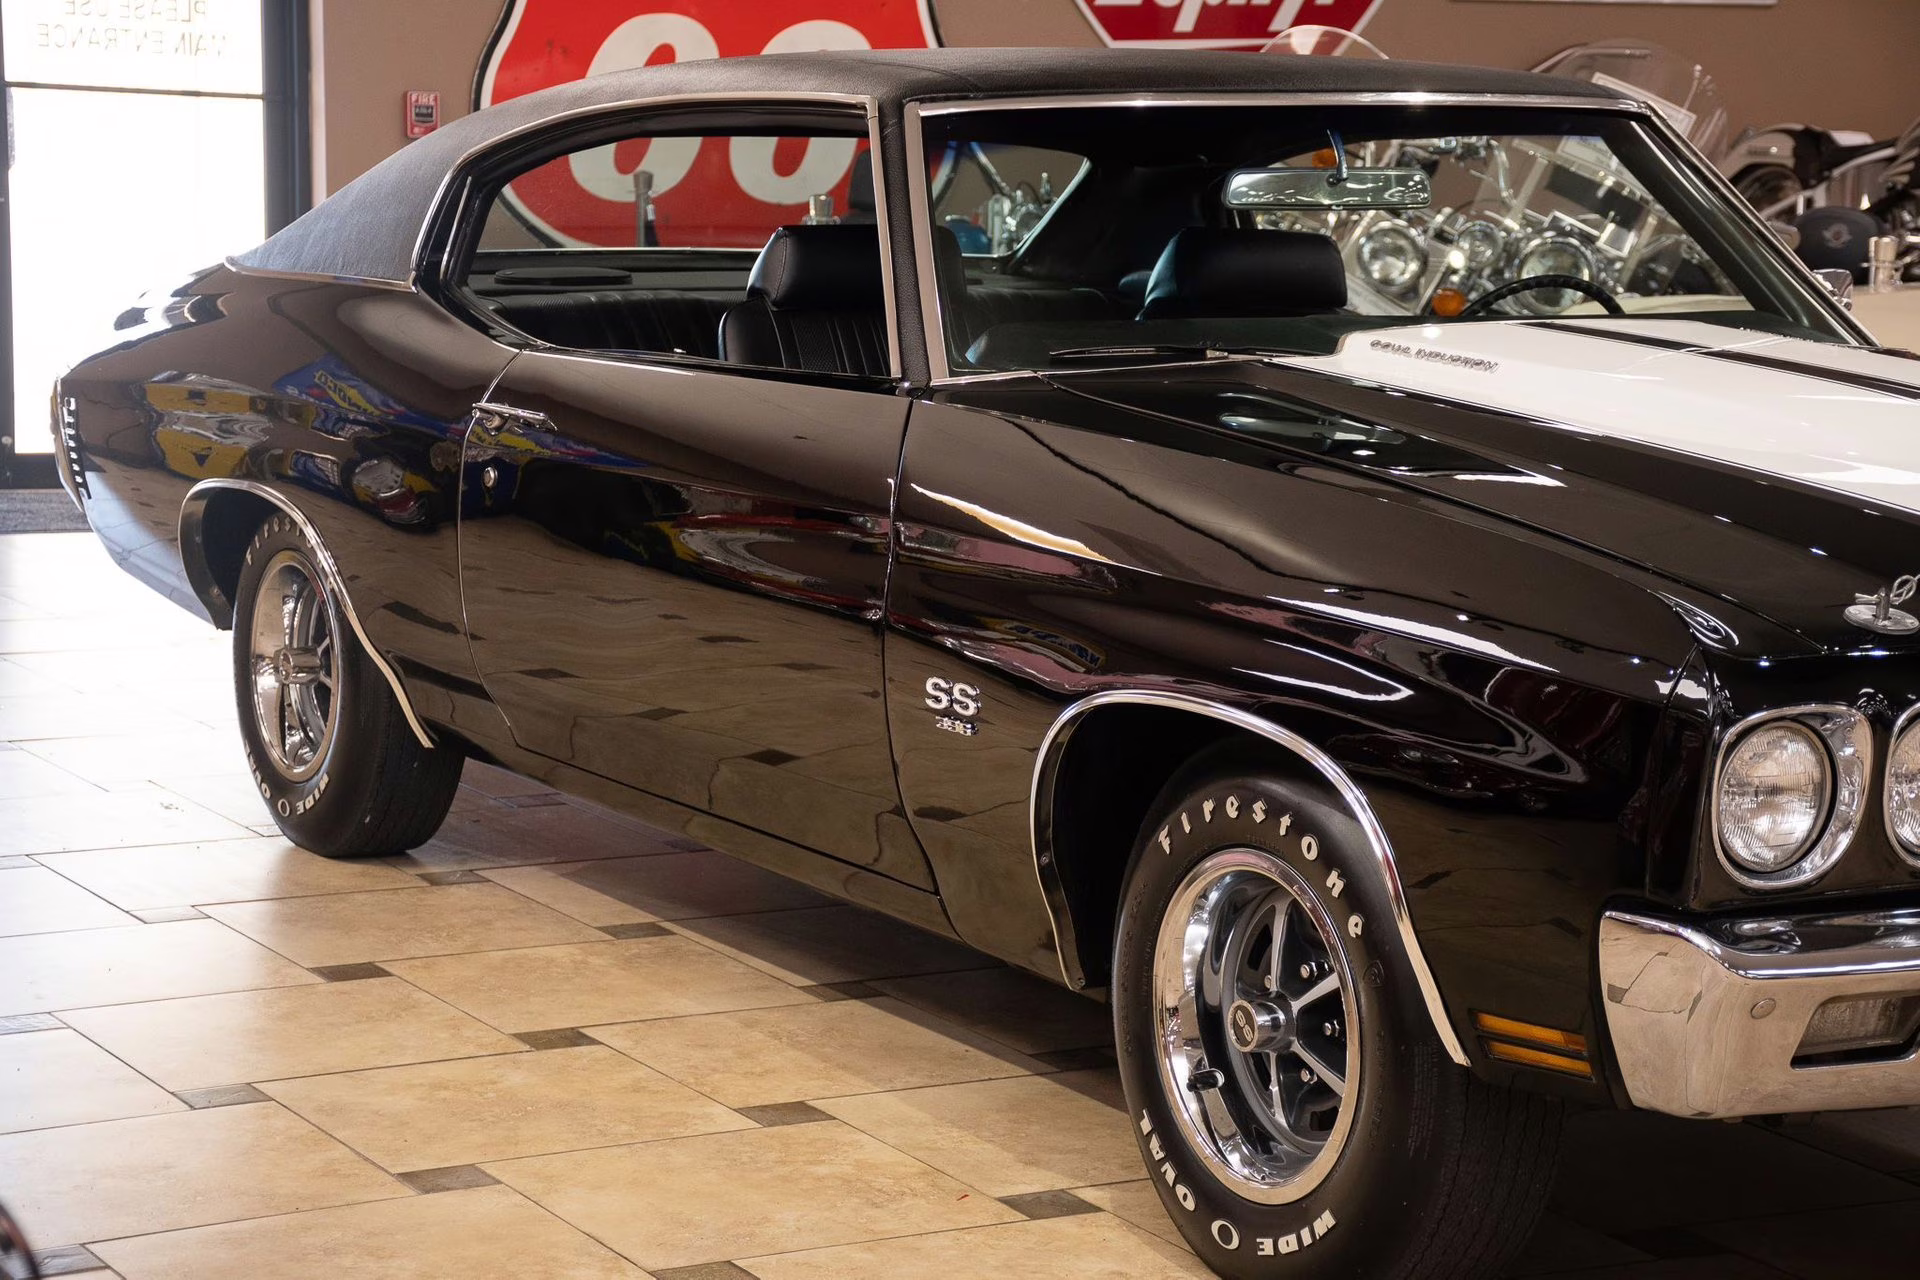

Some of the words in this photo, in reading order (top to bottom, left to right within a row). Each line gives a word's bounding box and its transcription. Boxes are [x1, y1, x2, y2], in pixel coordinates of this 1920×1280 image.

[411, 92, 436, 106] FIRE
[1414, 346, 1499, 373] INDUCTION
[924, 676, 982, 717] SS
[1235, 1009, 1254, 1042] SS
[1139, 1107, 1197, 1213] OVAL
[1255, 1208, 1337, 1257] WIDE
